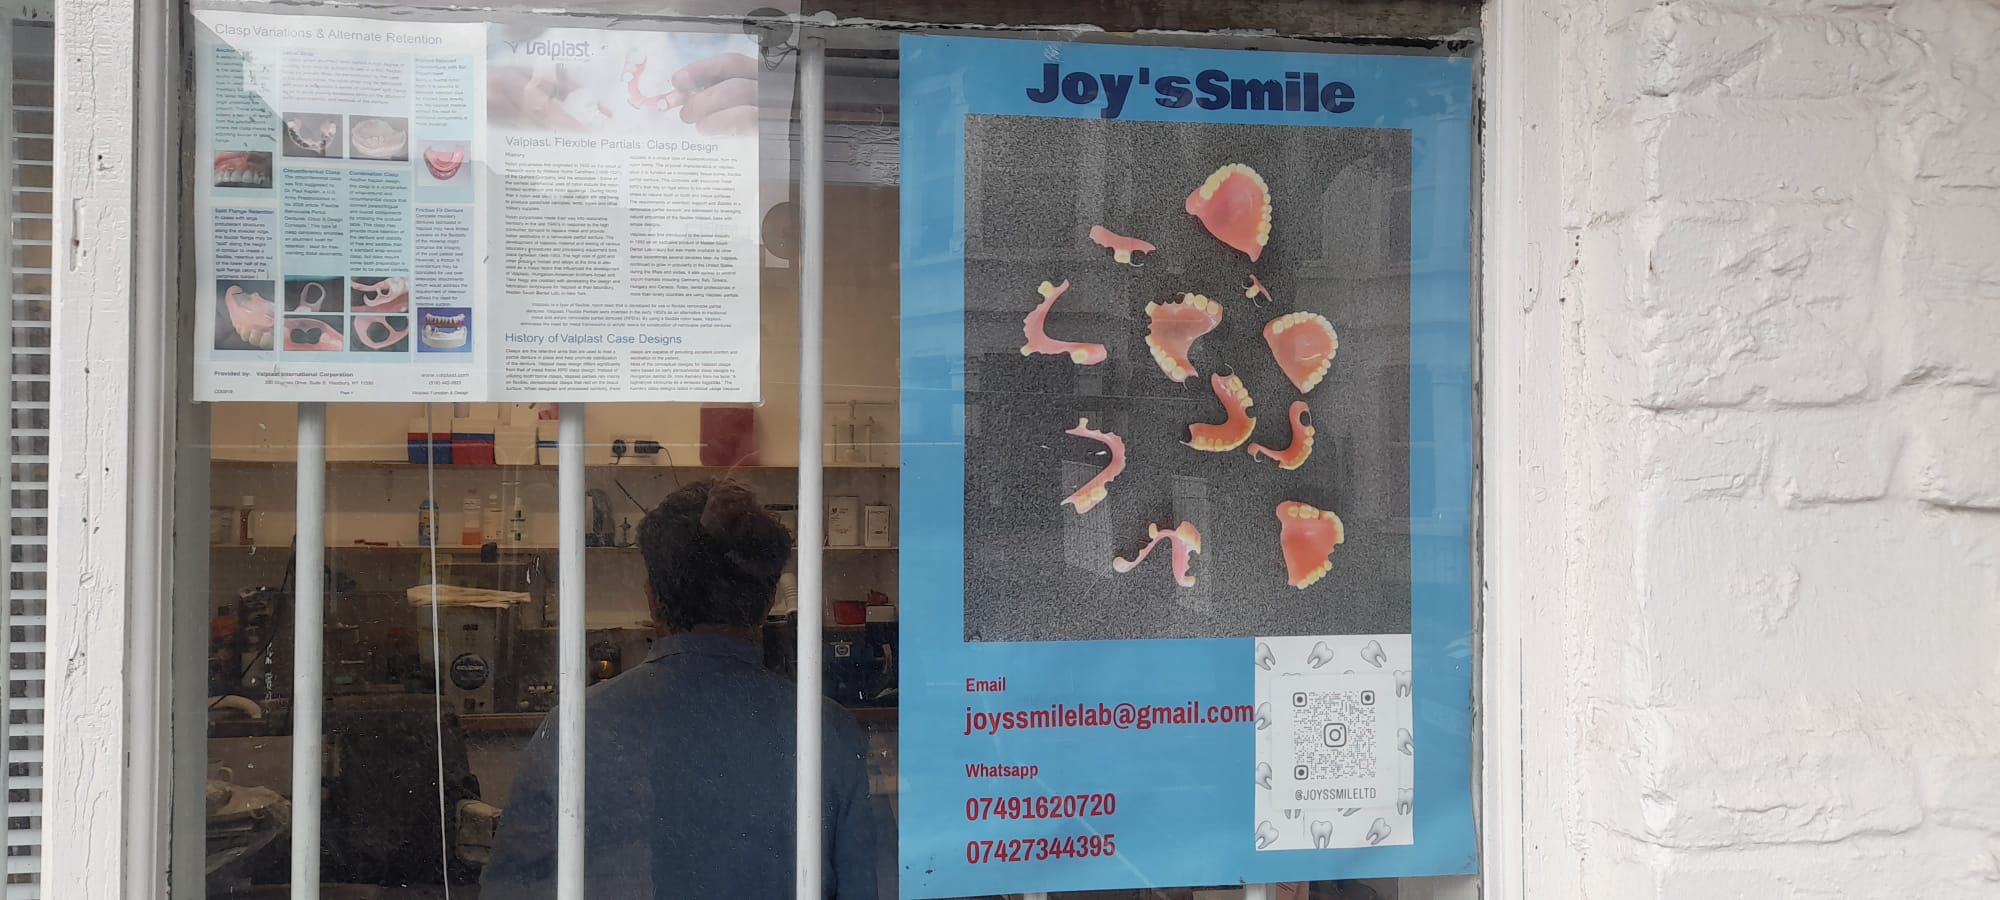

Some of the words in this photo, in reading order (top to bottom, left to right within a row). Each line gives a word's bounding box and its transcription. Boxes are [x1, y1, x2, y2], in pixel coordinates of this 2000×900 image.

[215, 24, 250, 38] Clasp
[252, 26, 312, 38] Variations
[316, 29, 324, 39] &
[328, 29, 382, 41] Alternate
[386, 32, 442, 45] Retention
[555, 137, 596, 148] Flexible
[647, 140, 678, 152] Clasp
[681, 141, 718, 153] Design
[505, 332, 544, 344] History
[548, 333, 559, 343] of
[560, 333, 603, 344] Valplast
[606, 334, 635, 343] Case
[638, 334, 682, 346] Designs
[966, 677, 1006, 692] Email
[964, 701, 1254, 735] joyssmilelab@gmail.com
[966, 764, 1038, 779] Whatsapp
[1295, 788, 1376, 800] @JOYSSMILELTD
[966, 793, 1116, 820] 07491620720
[966, 834, 1116, 864] 07427344395
